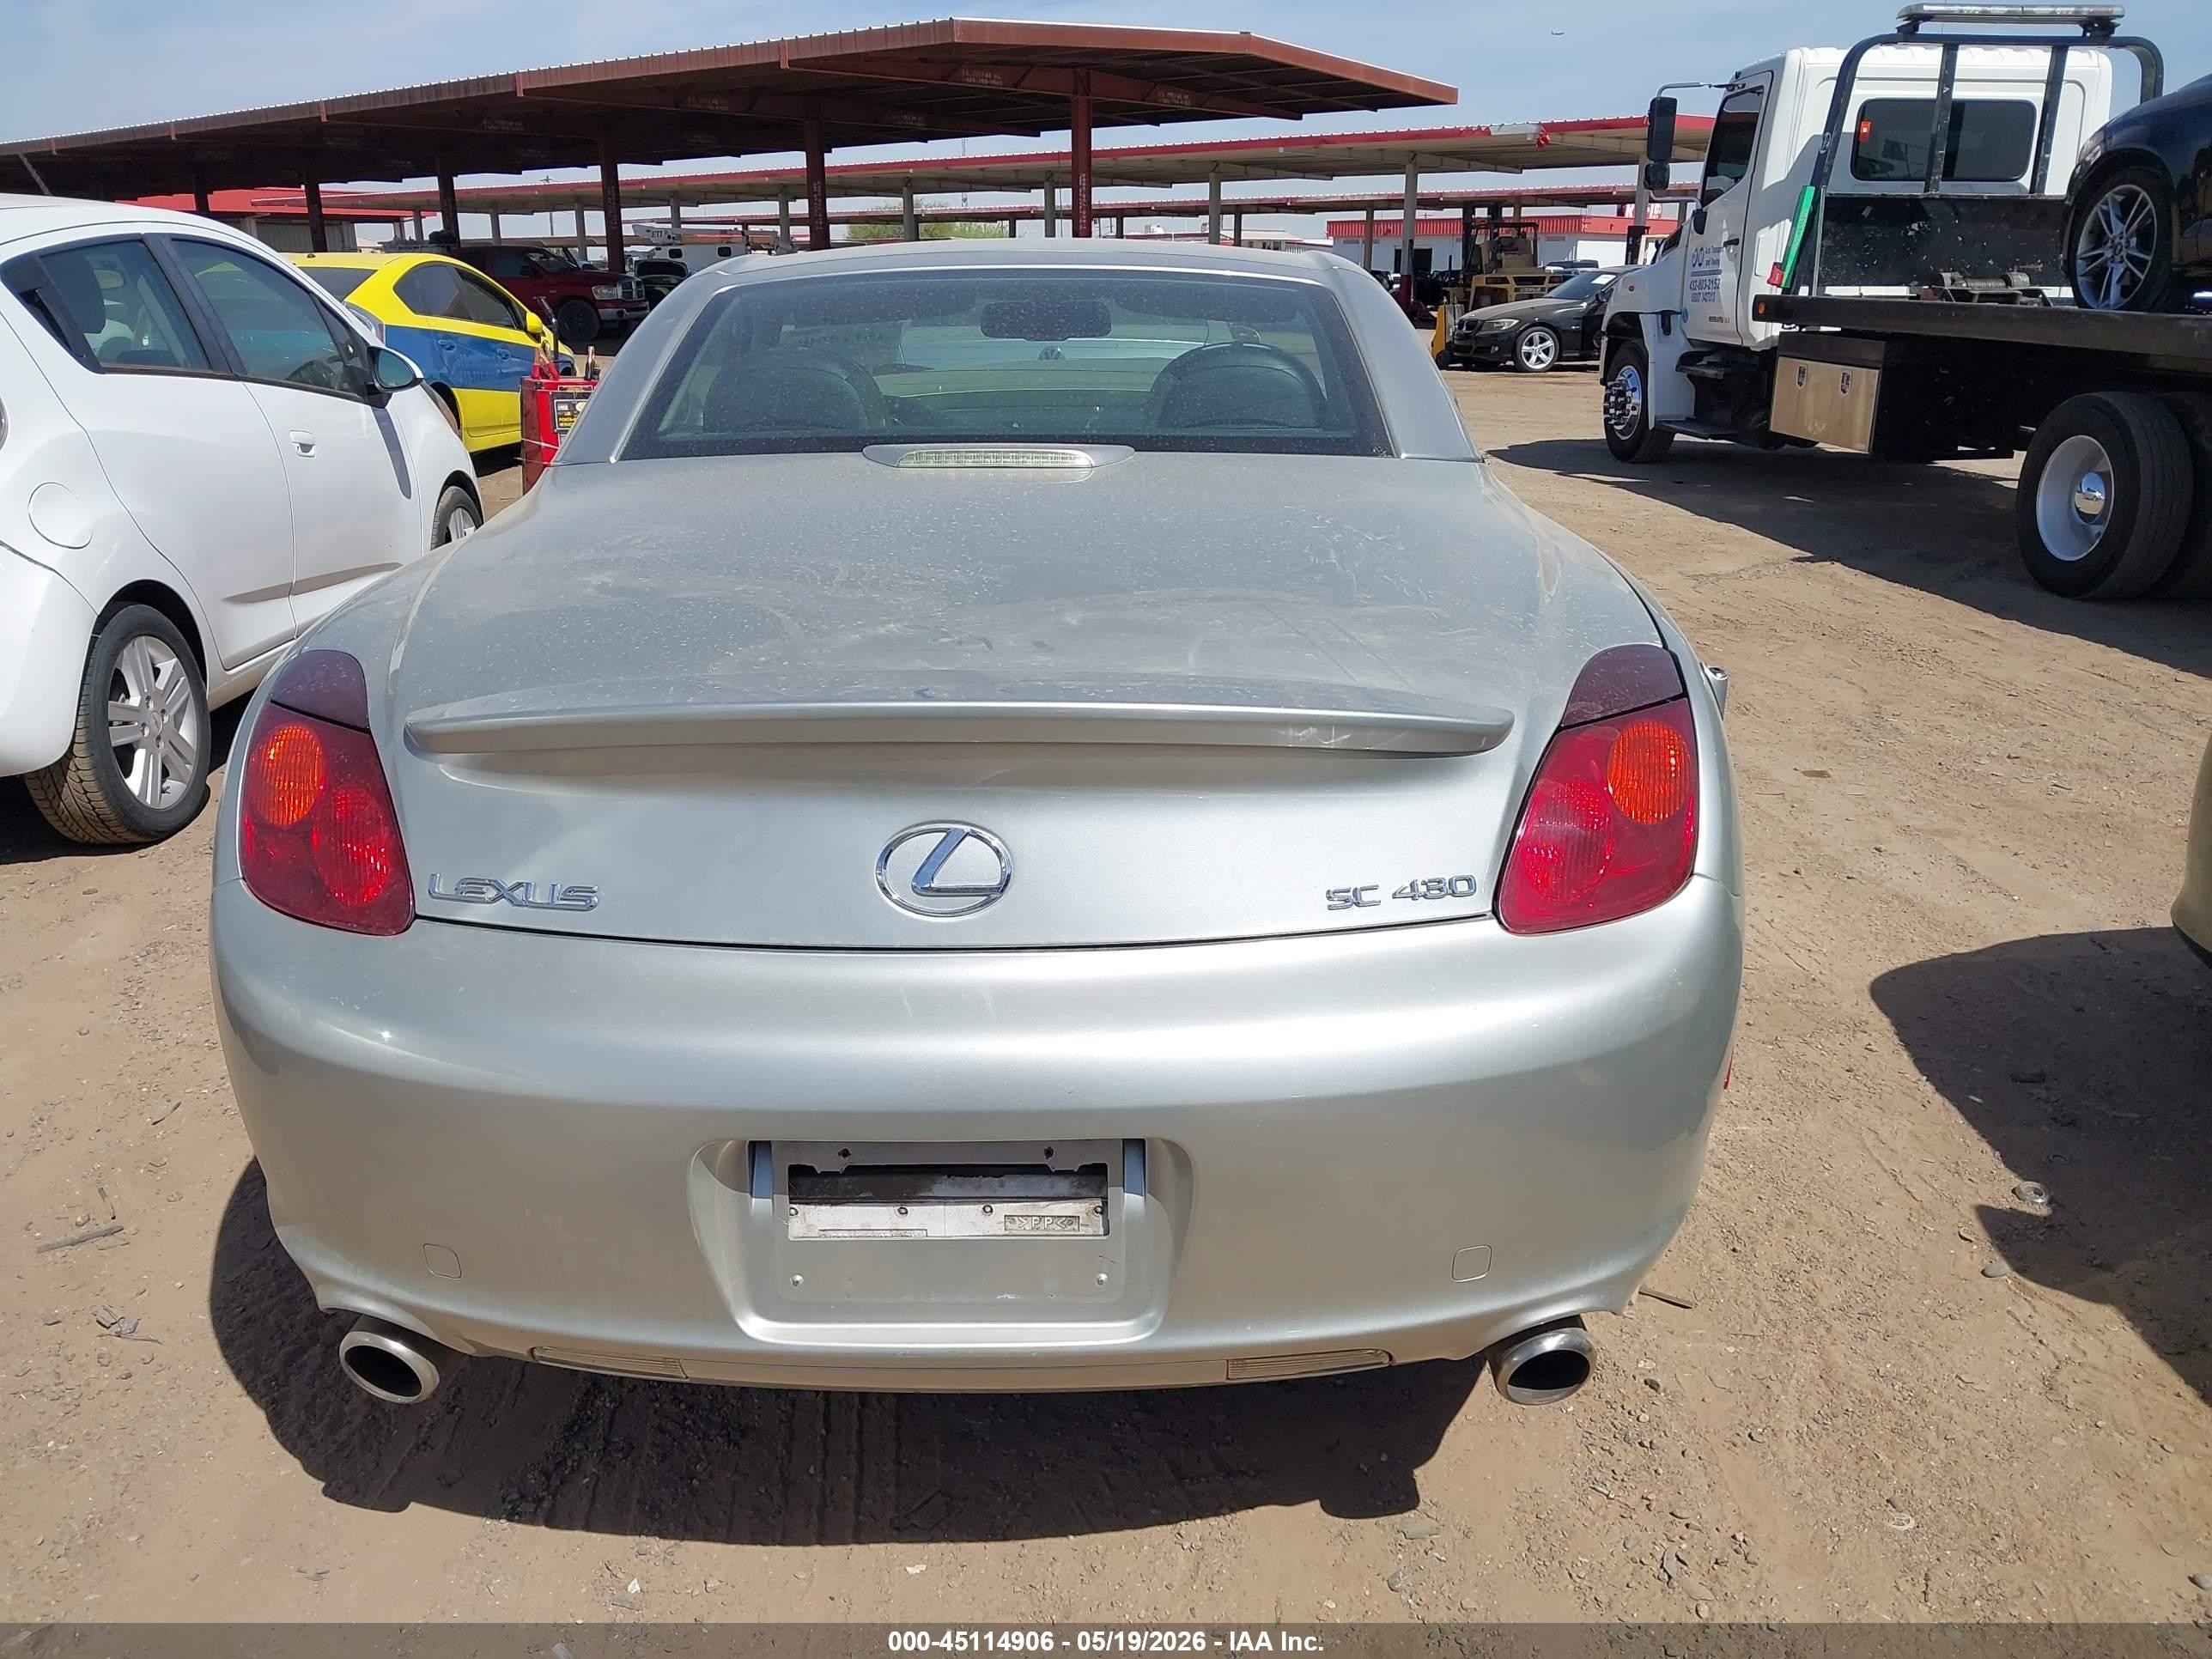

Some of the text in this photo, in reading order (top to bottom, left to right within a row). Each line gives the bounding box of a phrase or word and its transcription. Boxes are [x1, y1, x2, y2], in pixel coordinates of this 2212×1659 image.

[428, 872, 599, 913] LEXUS
[1325, 874, 1477, 911] SC 430
